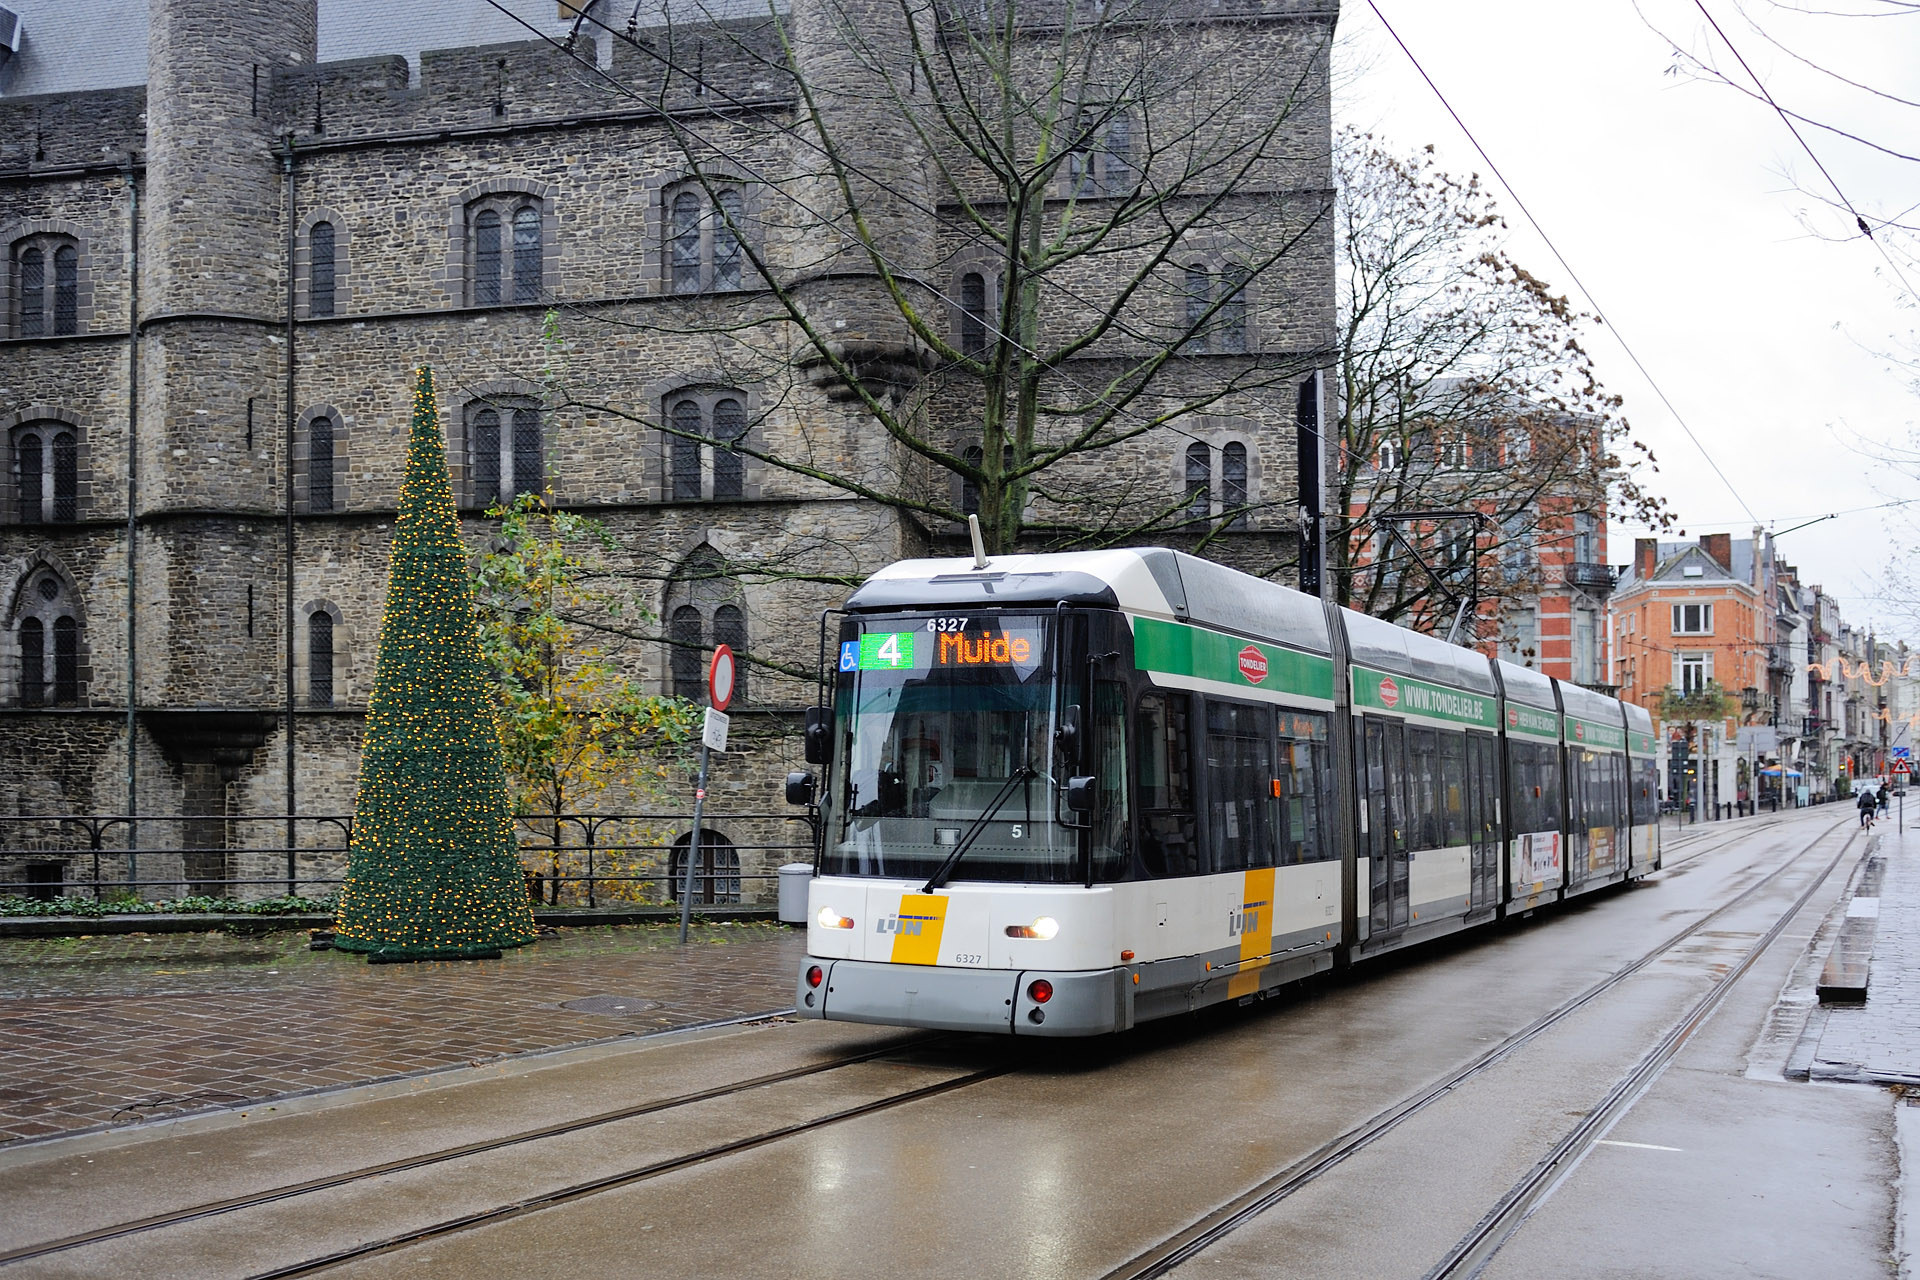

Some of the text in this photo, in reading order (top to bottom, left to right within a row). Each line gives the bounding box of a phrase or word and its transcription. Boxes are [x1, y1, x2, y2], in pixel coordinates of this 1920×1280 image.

[926, 617, 969, 632] 6327
[877, 631, 1030, 666] 4 Muide
[1240, 657, 1267, 672] TONDELIER
[1403, 684, 1484, 720] WWW.TONDELIER.BE
[1011, 824, 1022, 838] 5
[876, 918, 923, 936] LIJN
[1228, 910, 1259, 938] LIJN
[955, 953, 982, 965] 6327
